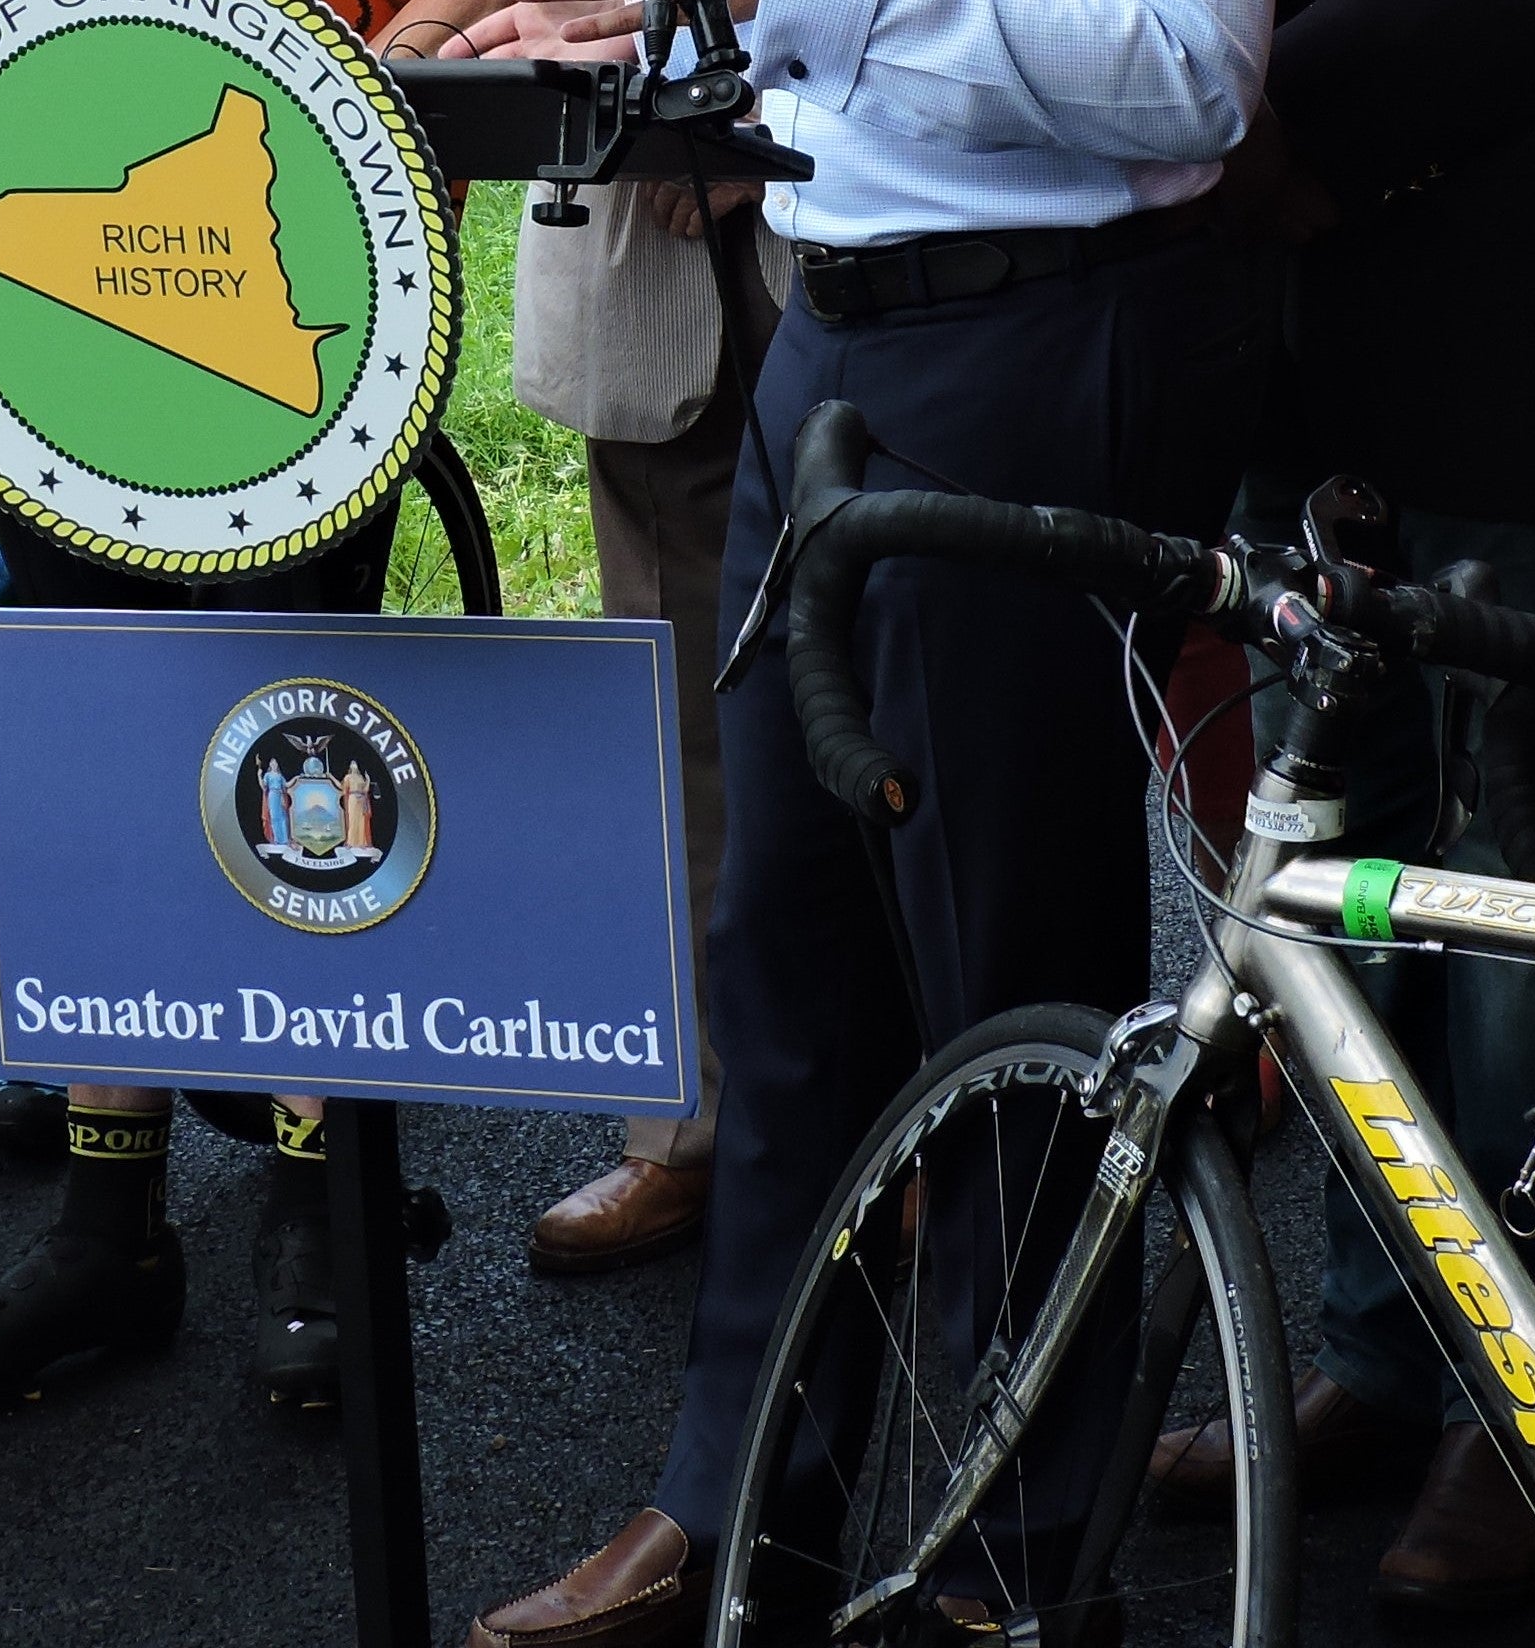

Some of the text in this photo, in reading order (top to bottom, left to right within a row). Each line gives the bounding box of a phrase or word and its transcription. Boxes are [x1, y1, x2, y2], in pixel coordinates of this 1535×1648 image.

[101, 224, 232, 256] RICH IN
[94, 267, 248, 299] HISTORY
[213, 688, 418, 785] NEW YORK STATE
[268, 884, 383, 923] SENATE
[1356, 879, 1369, 915] BAND
[14, 977, 664, 1067] Senator David Carlucci
[1231, 1304, 1259, 1462] BONTRAGER
